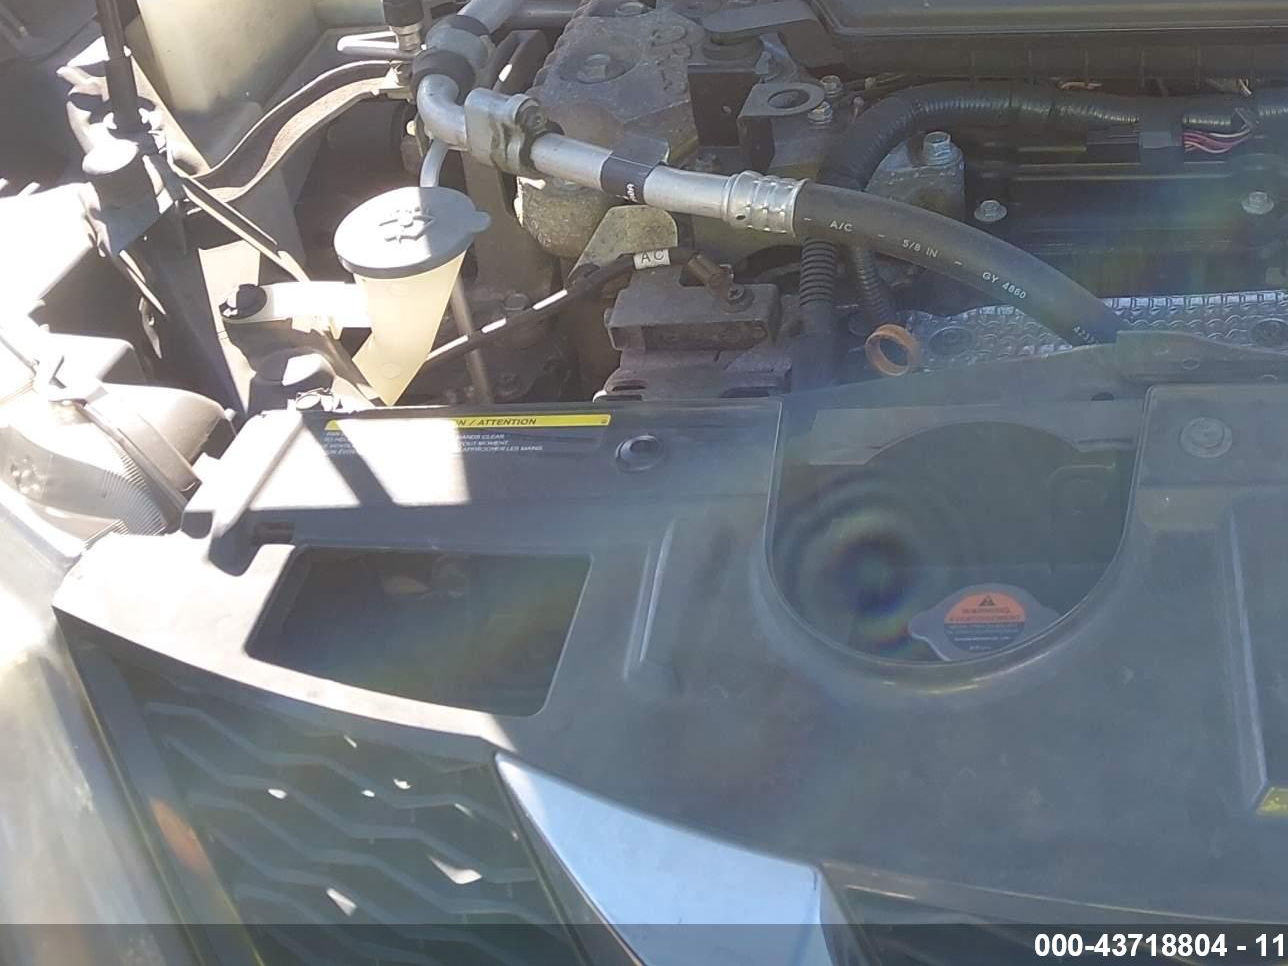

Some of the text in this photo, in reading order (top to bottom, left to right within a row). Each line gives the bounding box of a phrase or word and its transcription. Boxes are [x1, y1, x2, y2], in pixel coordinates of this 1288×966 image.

[829, 220, 854, 232] A/C
[902, 239, 921, 252] 5/8
[926, 247, 938, 258] IN
[982, 271, 999, 283] GY
[477, 418, 536, 426] ATTENTION
